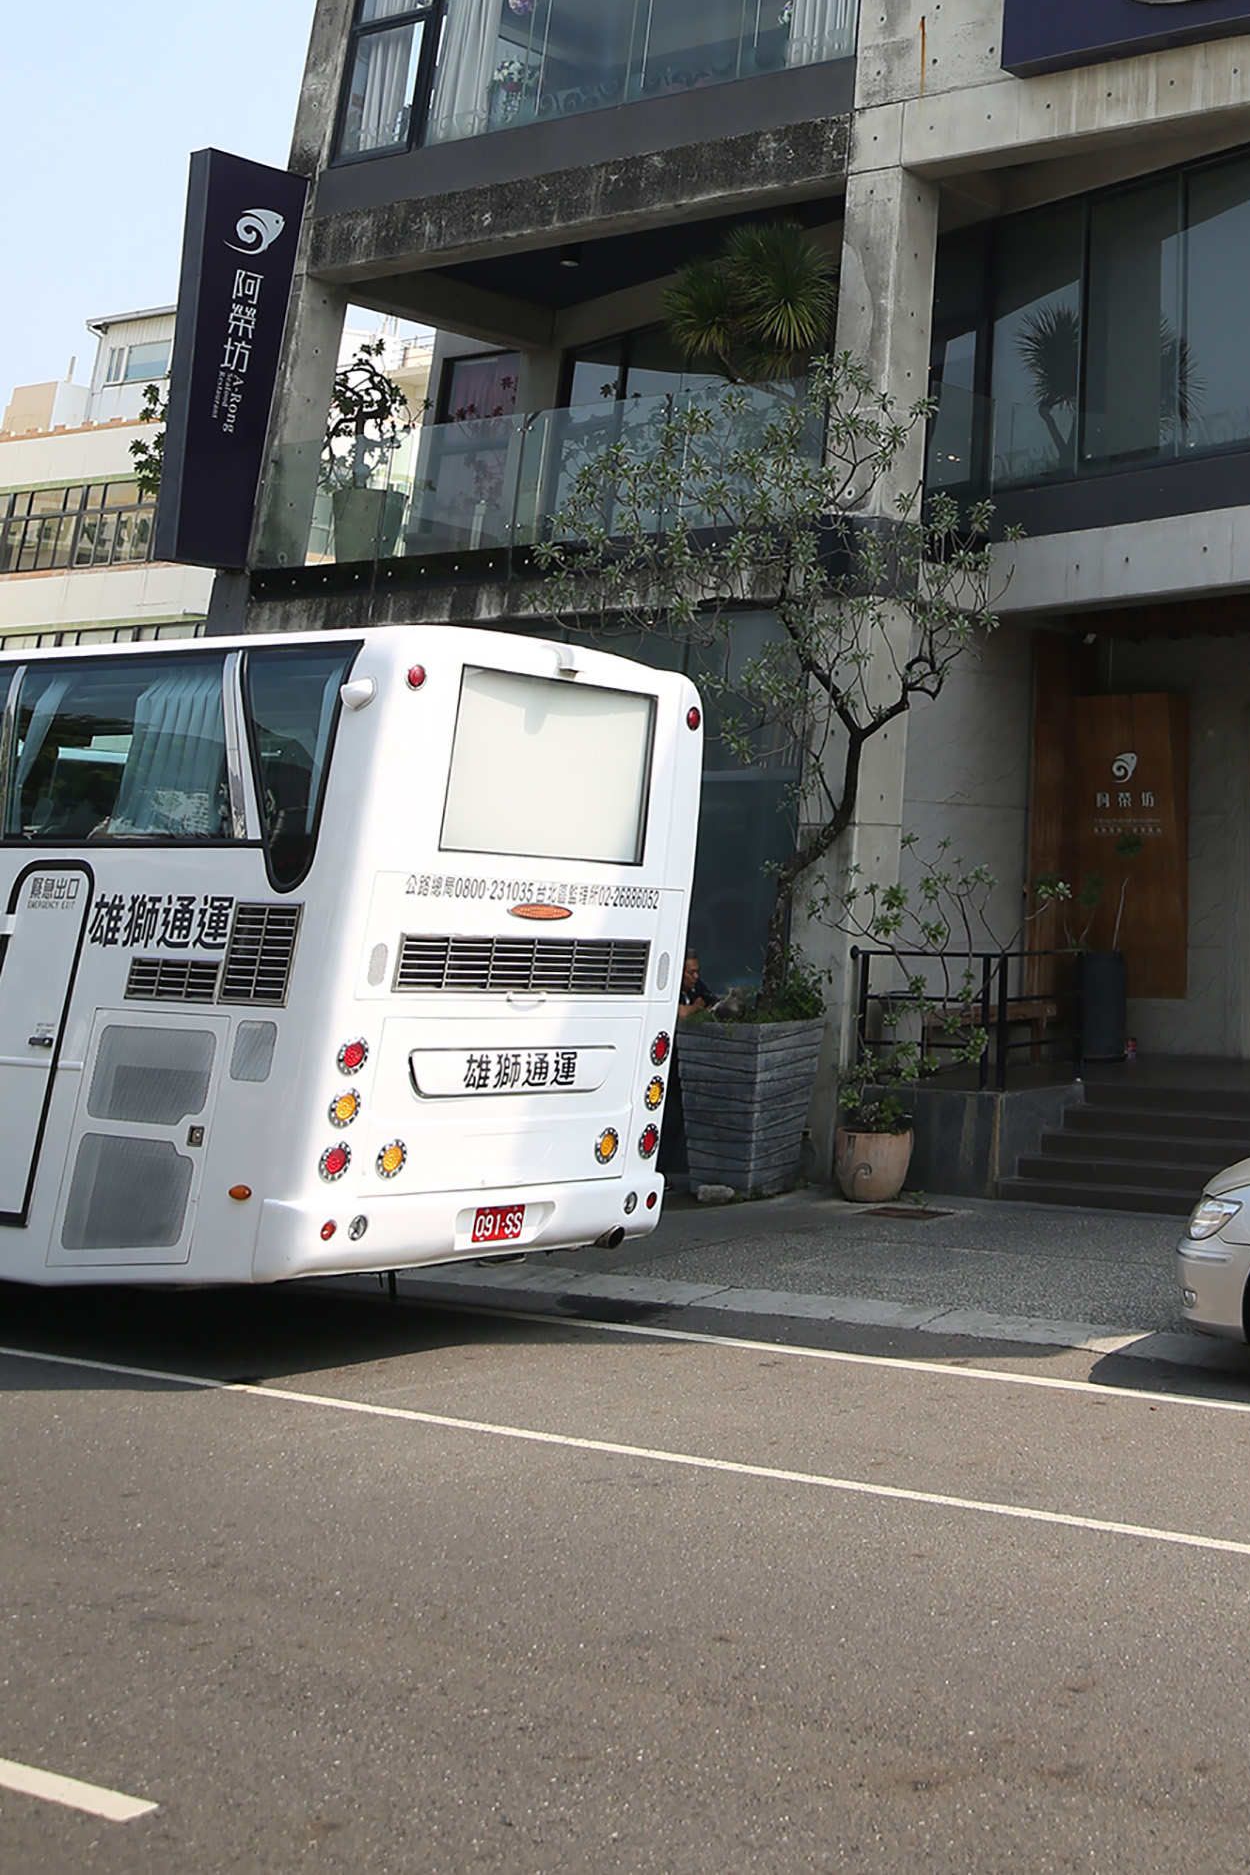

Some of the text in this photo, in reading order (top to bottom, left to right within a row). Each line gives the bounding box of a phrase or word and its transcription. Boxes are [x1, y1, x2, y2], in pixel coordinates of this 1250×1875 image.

[220, 269, 264, 373] 阿榮坊
[29, 876, 81, 900] 緊急出口
[88, 893, 235, 949] 雄獅通運
[463, 1051, 578, 1090] 雄獅通運
[474, 1212, 523, 1238] 091-SS
